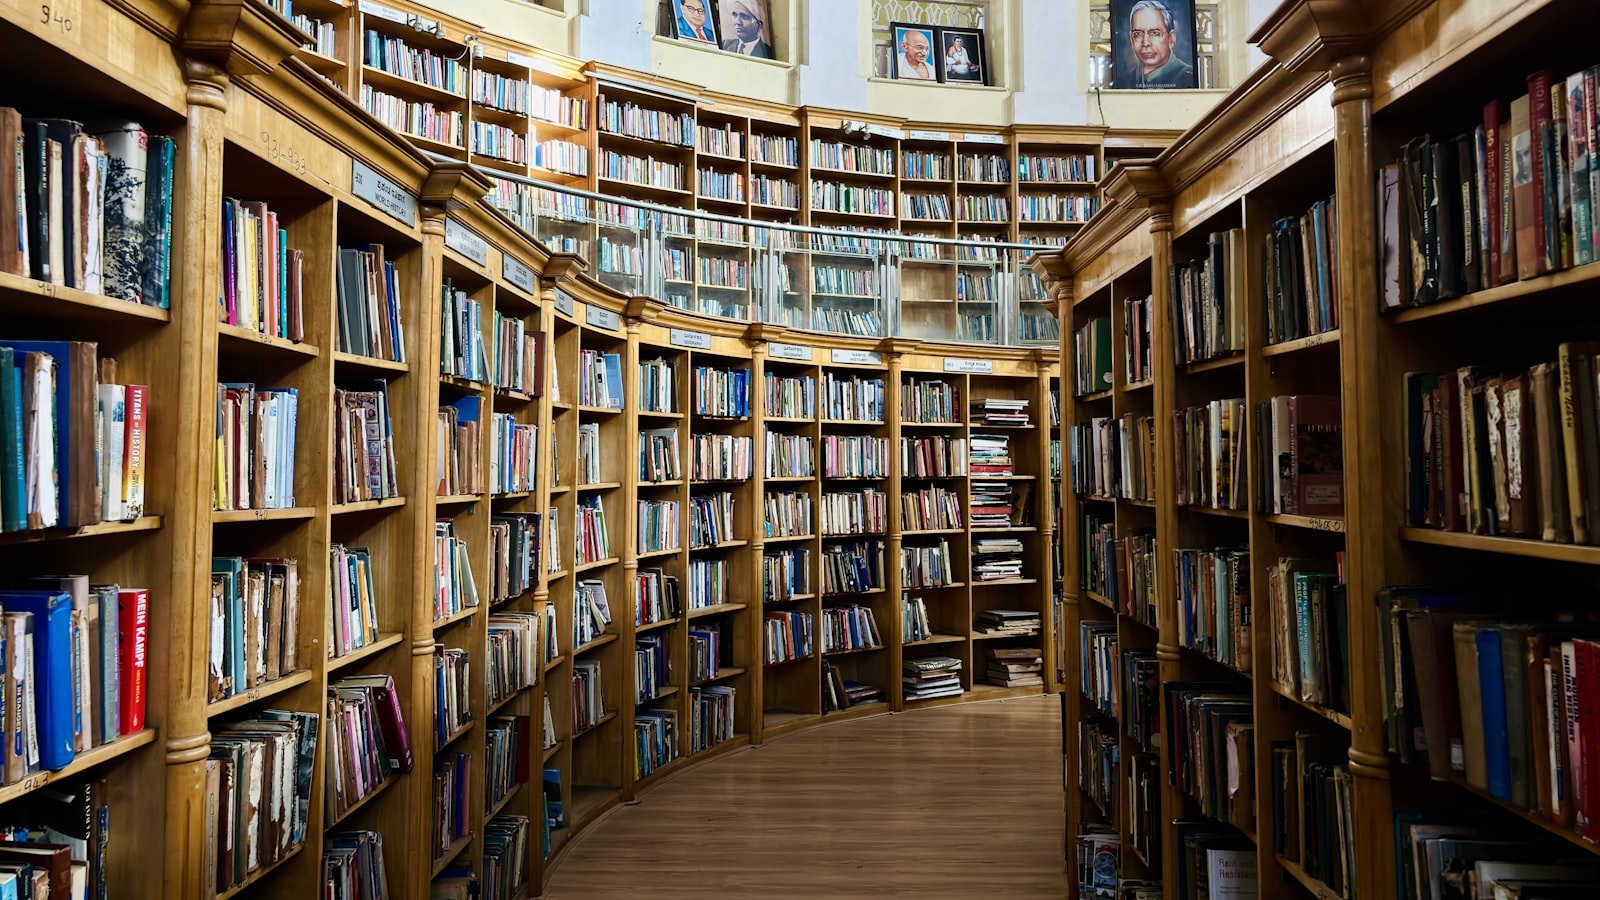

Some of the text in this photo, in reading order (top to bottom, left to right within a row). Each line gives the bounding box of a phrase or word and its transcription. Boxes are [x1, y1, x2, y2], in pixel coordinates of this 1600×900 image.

[41, 5, 72, 34] 940
[1535, 77, 1545, 110] INDIA
[375, 192, 390, 208] WORLD
[390, 202, 407, 217] HISTORY
[133, 389, 142, 421] TITANS
[131, 429, 141, 468] HISTORY
[134, 593, 146, 668] MEIN KAMPF
[17, 687, 23, 695] IN
[1563, 655, 1575, 743] INDIAN HISTORY
[24, 772, 49, 792] 943
[1219, 858, 1236, 868] Raid
